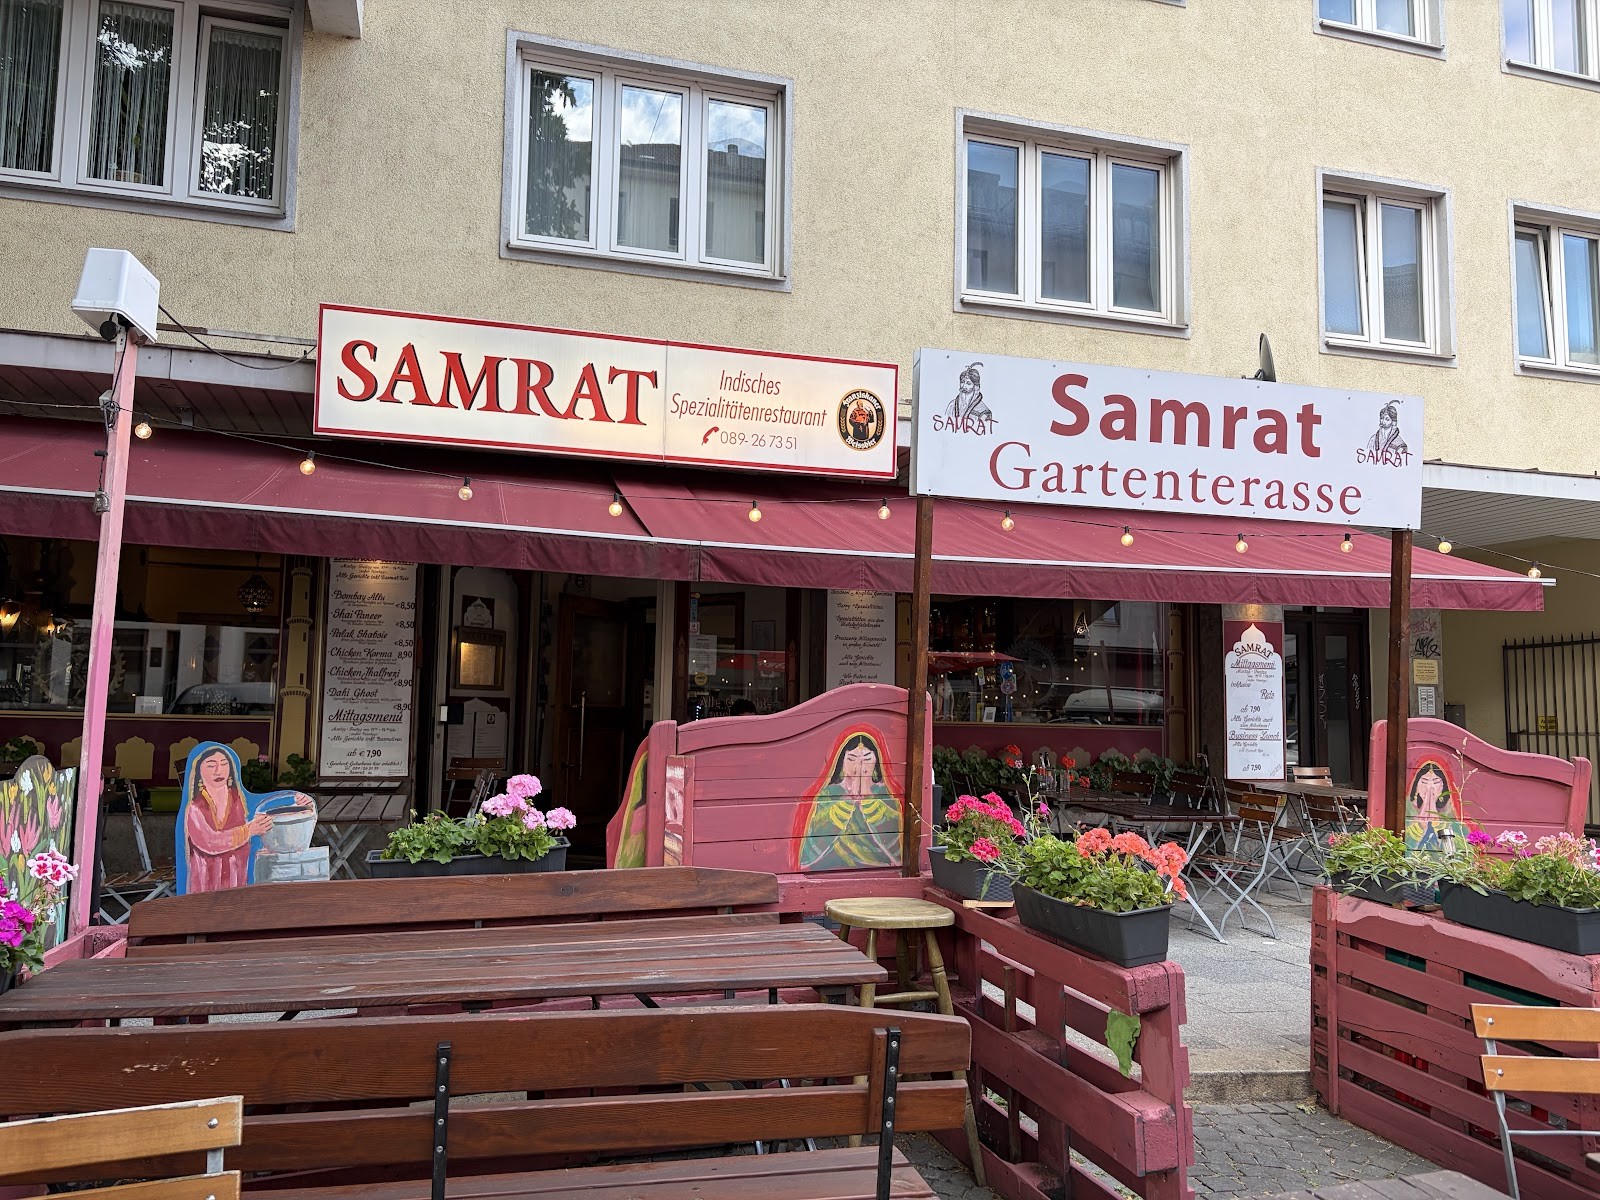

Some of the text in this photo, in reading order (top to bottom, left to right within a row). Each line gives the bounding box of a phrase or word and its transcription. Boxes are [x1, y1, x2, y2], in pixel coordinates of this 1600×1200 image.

[337, 339, 659, 427] SAMRAT
[719, 369, 782, 396] Indisches
[842, 391, 882, 410] Franziskaner
[670, 393, 827, 429] Spezialitätenrestaurant
[1050, 373, 1323, 458] Samrat
[932, 413, 999, 437] SAMRAT
[845, 435, 877, 449] Weissbier
[1356, 447, 1414, 468] SAMRAT
[989, 441, 1363, 516] Gartenterasse
[332, 590, 367, 603] Bombay
[332, 608, 382, 620] Shai Paneer
[331, 627, 355, 639] Palak
[330, 646, 413, 660] Chicken Korma 8,90
[1234, 642, 1273, 659] SAMRAT
[329, 666, 362, 677] Chicken
[328, 687, 351, 697] Dahi
[351, 688, 379, 701] Ghost
